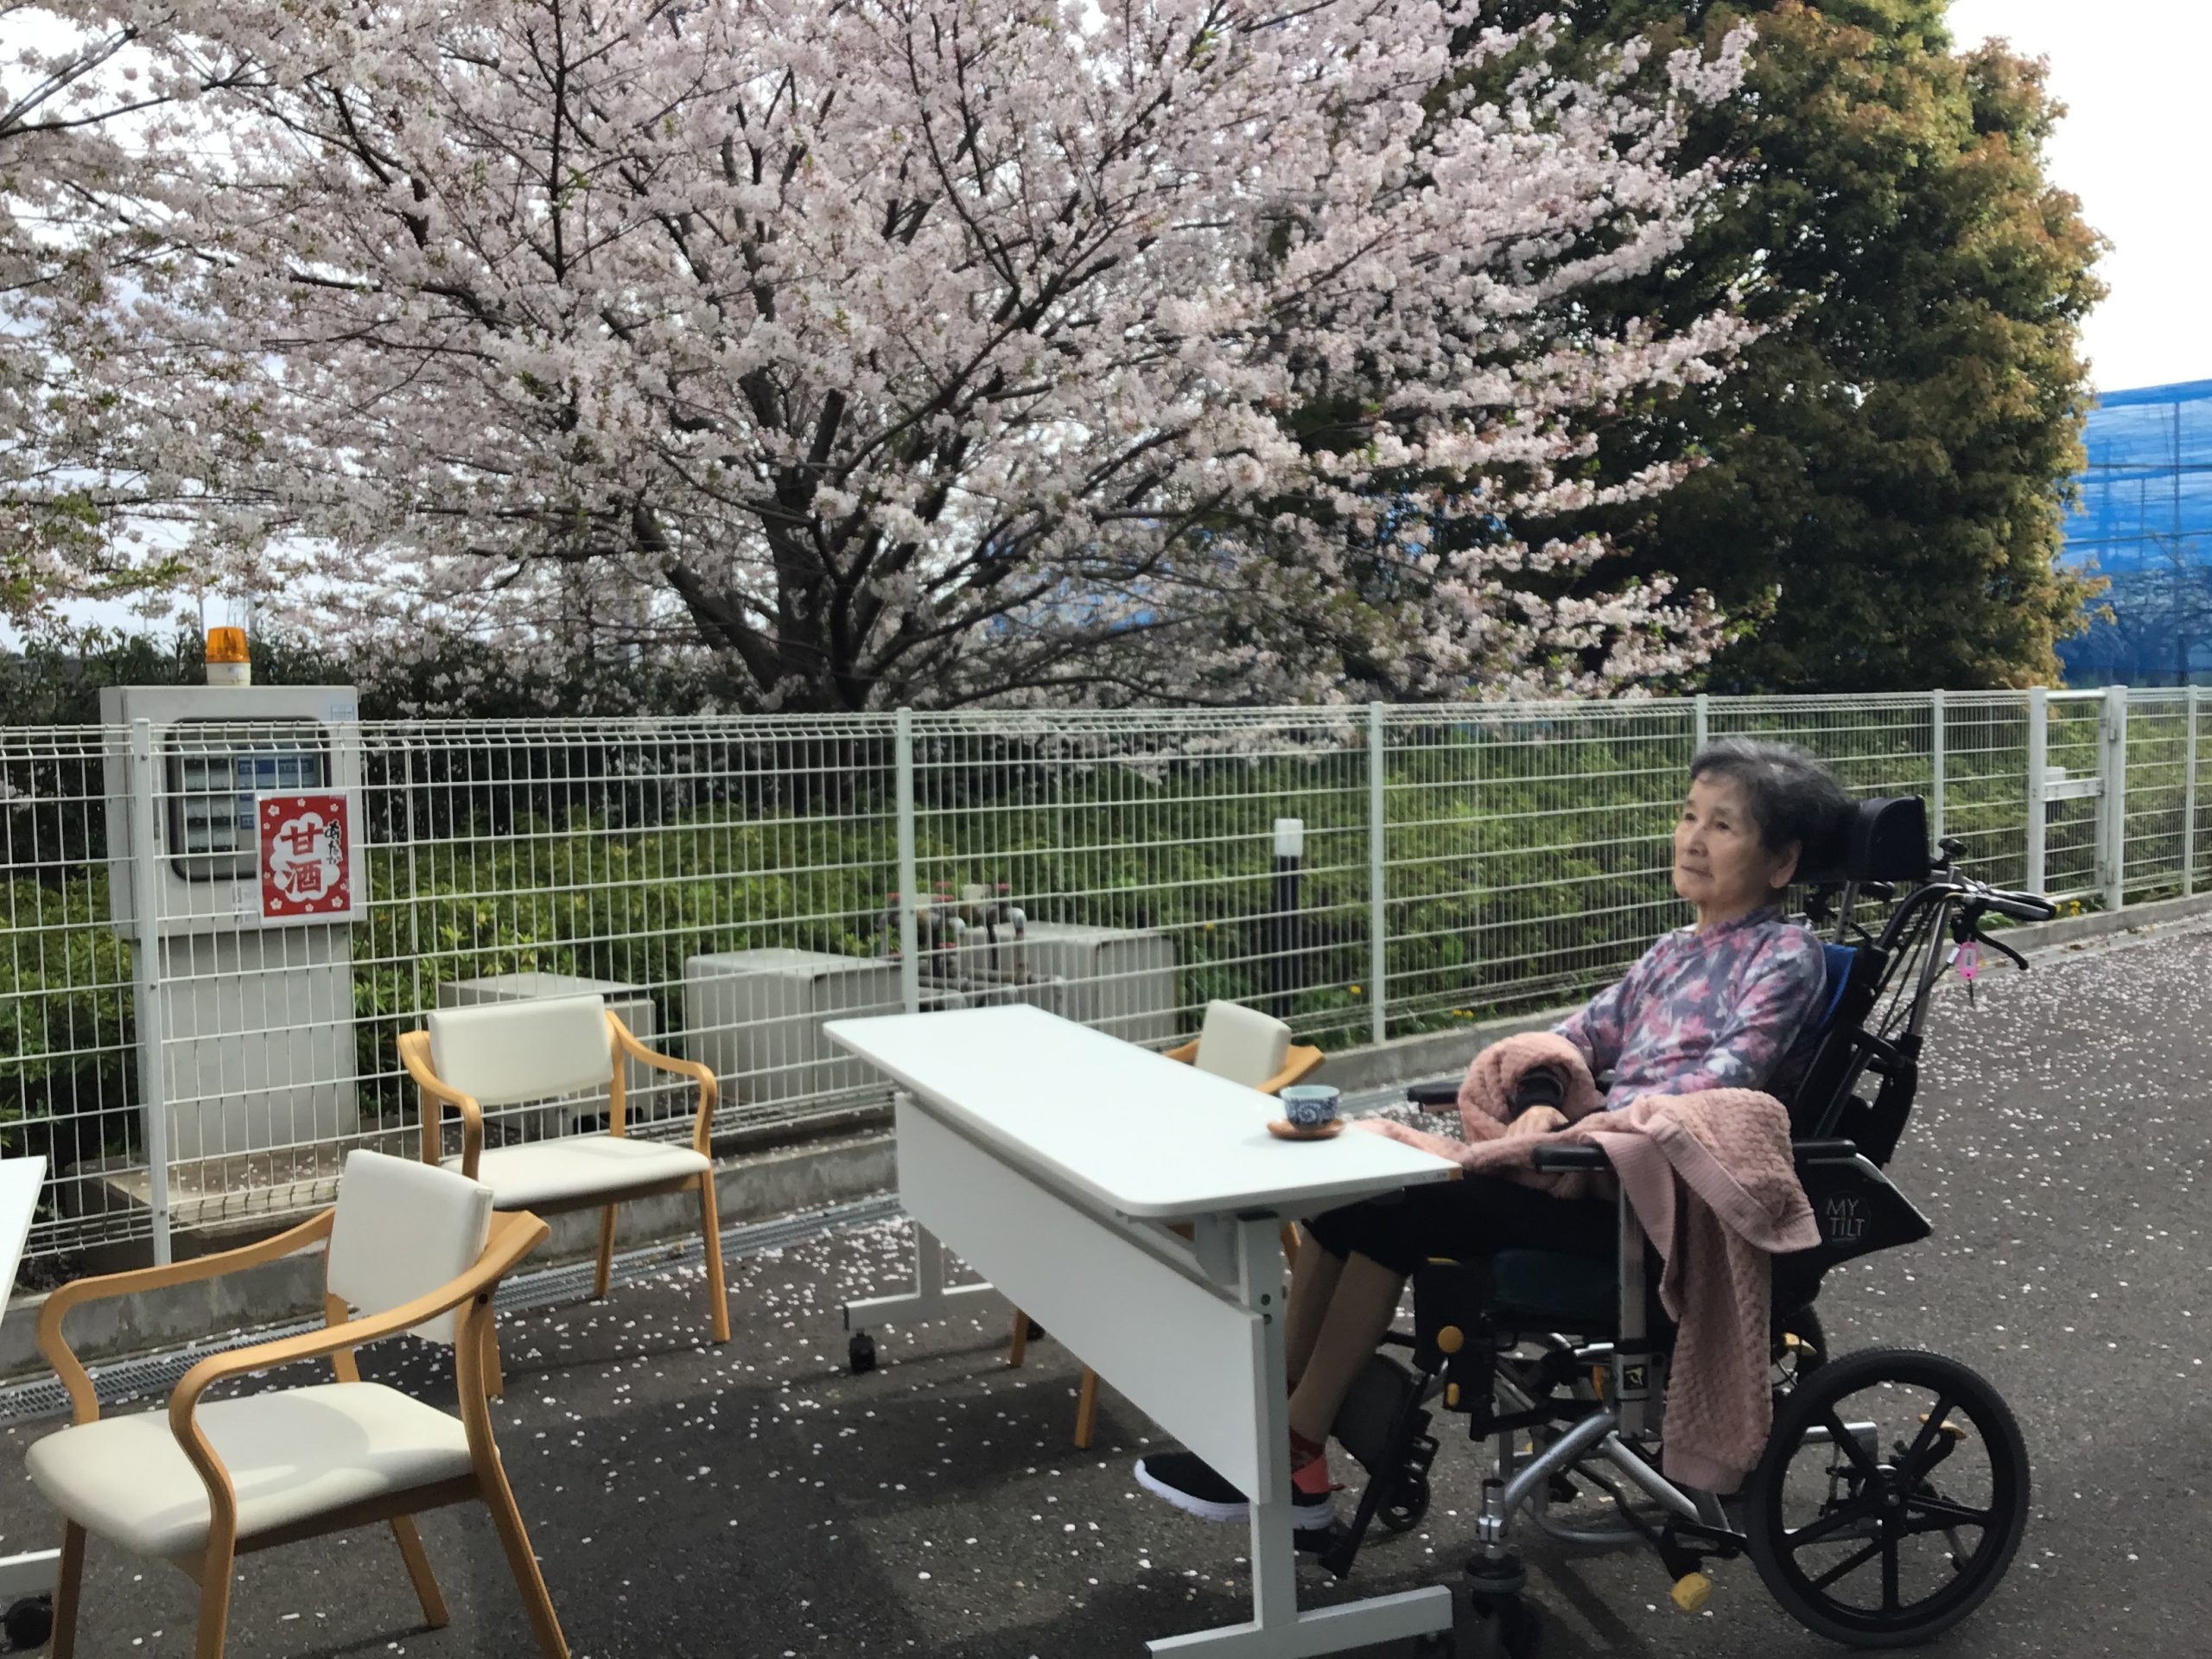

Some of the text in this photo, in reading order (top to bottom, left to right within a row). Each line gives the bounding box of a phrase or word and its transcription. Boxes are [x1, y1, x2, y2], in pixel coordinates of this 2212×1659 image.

[280, 821, 323, 893] 甘酒
[1827, 1198, 1859, 1217] MY
[1829, 1217, 1866, 1237] TILT
